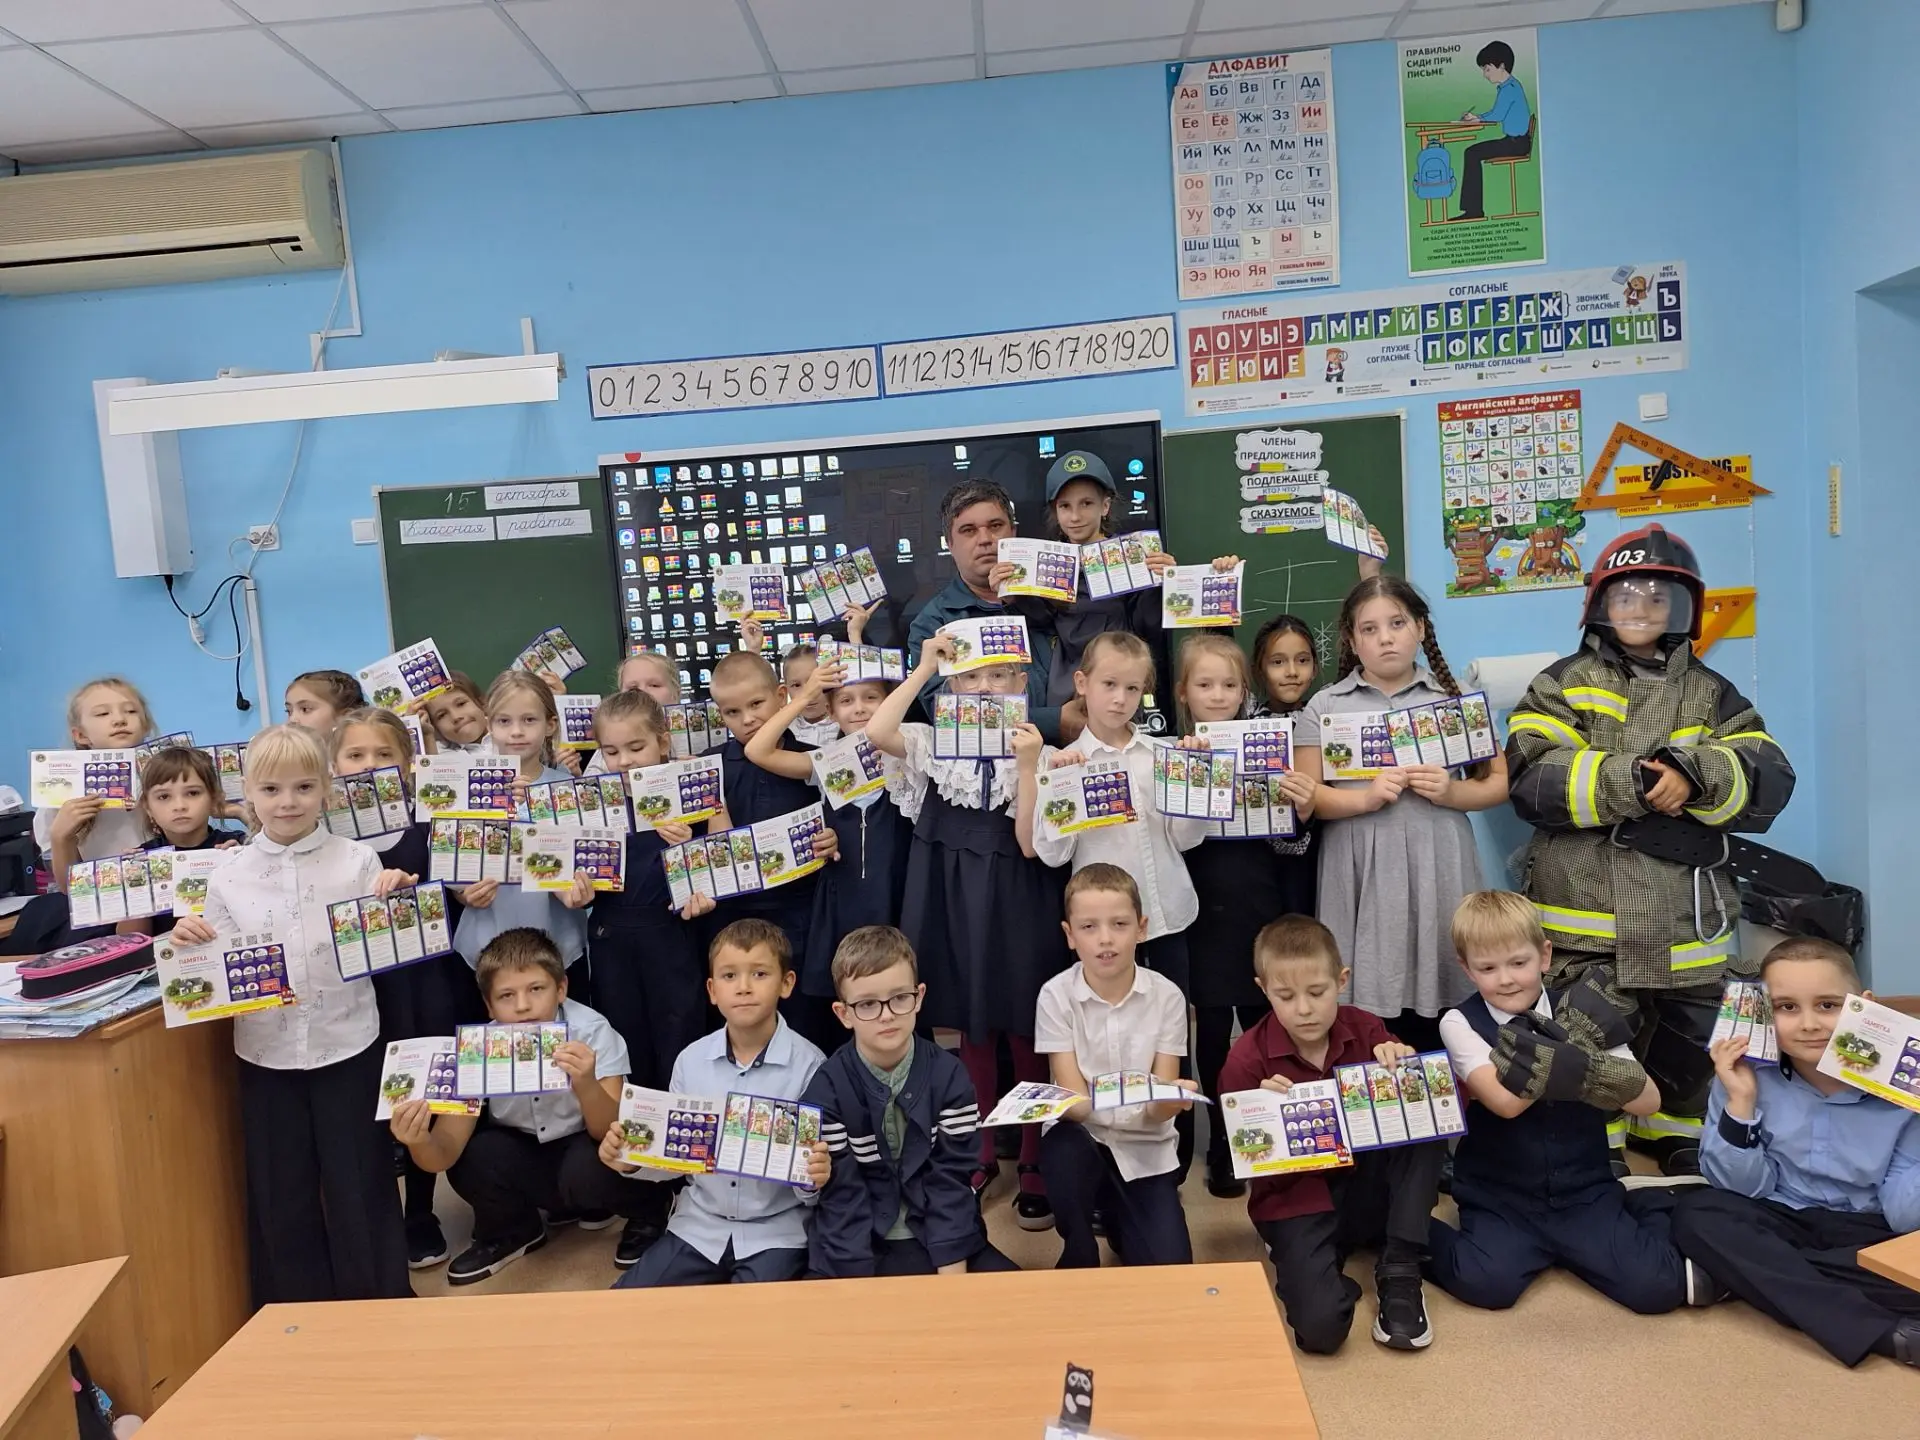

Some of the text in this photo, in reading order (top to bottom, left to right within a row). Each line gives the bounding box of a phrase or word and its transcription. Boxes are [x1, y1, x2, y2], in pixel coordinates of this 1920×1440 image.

[1406, 45, 1461, 57] ПРАВИЛЬНО
[1208, 55, 1289, 74] АЛФАВИТ
[1407, 57, 1452, 68] СИДИ ПРИ
[1407, 68, 1443, 79] ПИСЬМЕ
[1180, 76, 1320, 98] Аа Бб Вв Гг Дд
[1182, 107, 1321, 128] Ее Ёё Жж Зз Ии
[1183, 137, 1323, 159] Йй Кк Лл Мм Нн
[1185, 167, 1322, 189] Оо Пп Рр Сс Тт
[1187, 197, 1325, 222] Уу Фф Хх Цц Чч
[1185, 239, 1209, 251] Шш
[1213, 236, 1240, 249] Щщ
[1189, 265, 1266, 282] Ээ Юю Яя
[1449, 282, 1508, 297] СОГЛАСНЫЕ
[1576, 293, 1610, 302] ЗВОНКИЕ
[1660, 287, 1677, 306] Ъ
[1222, 307, 1267, 320] ГЛАСНЫЕ
[1576, 301, 1620, 312] СОГЛАСНЫЕ
[1194, 298, 1562, 353] А О У Ы Э Л М Н Р Й Б В Г З Д Ж
[1427, 317, 1676, 358] П Ф К С Т Ш Х Ц Ч Щ Ь
[888, 327, 1168, 384] 11 12 13 14 15 16 17 18 19 20
[1382, 344, 1410, 354] ГЛУХИЕ
[1367, 354, 1411, 364] СОГЛАСНЫЕ
[1455, 356, 1532, 370] ПАРНЫЕ СОГЛАСНЫЕ
[1197, 356, 1299, 383] Я Ё Ю И Е
[599, 358, 872, 407] 0 1 2 3 4 5 6 7 8 9 10
[1455, 394, 1564, 411] Английский алфавит
[1508, 405, 1536, 413] Alphabet
[1261, 437, 1296, 447] ЧЛЕНЫ
[1240, 451, 1316, 460] ПРЕДЛОЖЕНИЯ
[1247, 473, 1319, 486] ПОДЛЕЖАЩЕЕ
[445, 491, 476, 513] 15
[1251, 507, 1315, 519] СКАЗУЕМОЕ
[405, 513, 574, 539] Классная работа
[1607, 550, 1645, 569] 103
